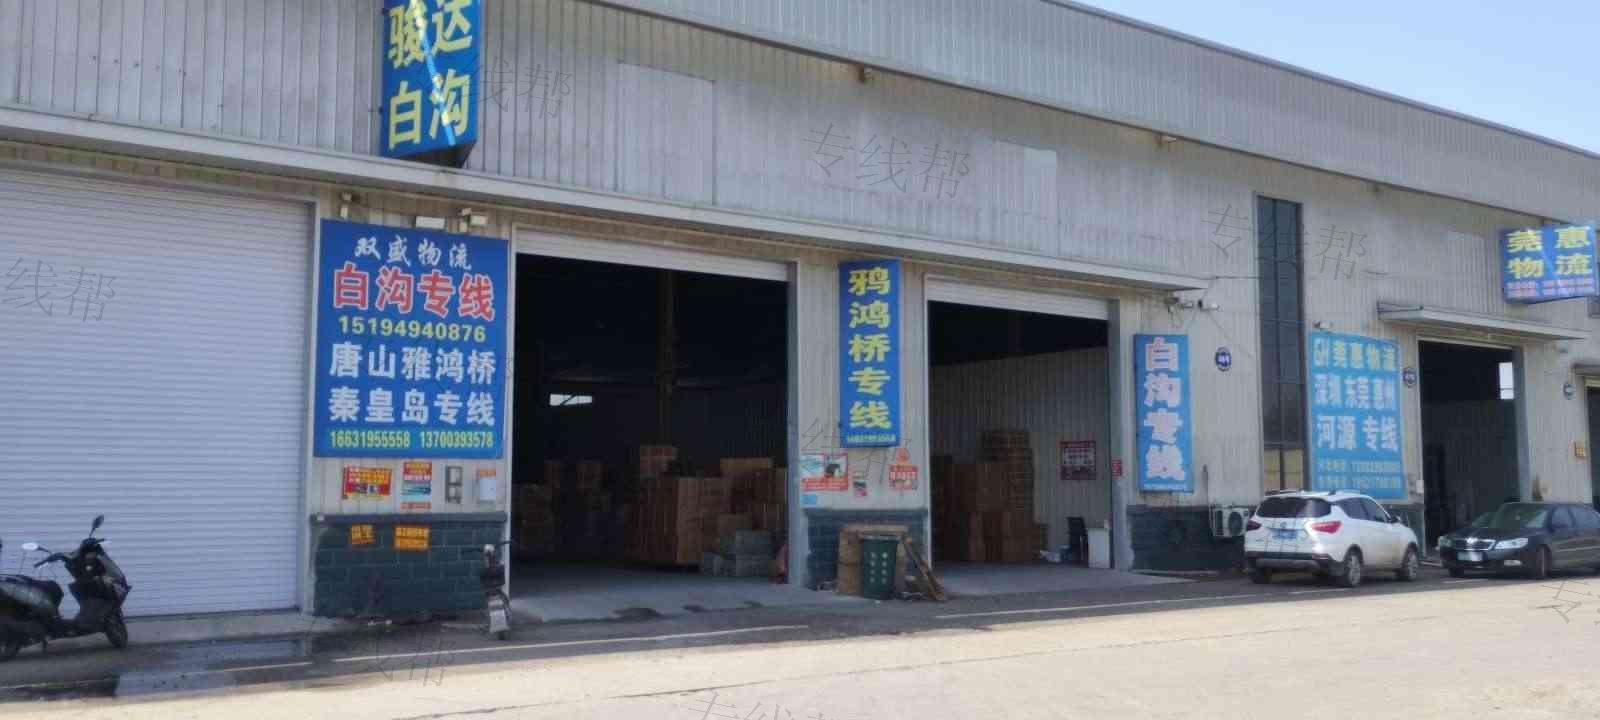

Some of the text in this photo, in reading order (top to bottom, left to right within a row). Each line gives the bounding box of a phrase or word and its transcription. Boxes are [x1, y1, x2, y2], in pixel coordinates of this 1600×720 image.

[388, 68, 470, 151] 白沟
[355, 234, 472, 271] 双盛物流
[1506, 226, 1592, 254] 莞惠
[1507, 254, 1593, 279] 物流
[333, 261, 496, 322] 白沟专线
[338, 315, 487, 343] 15194940876
[847, 266, 891, 430] 鸦鸿桥专线
[329, 341, 497, 385] 唐山雅鸿桥
[328, 386, 496, 427] 秦皇岛专线
[1143, 336, 1186, 481] 白沟专线
